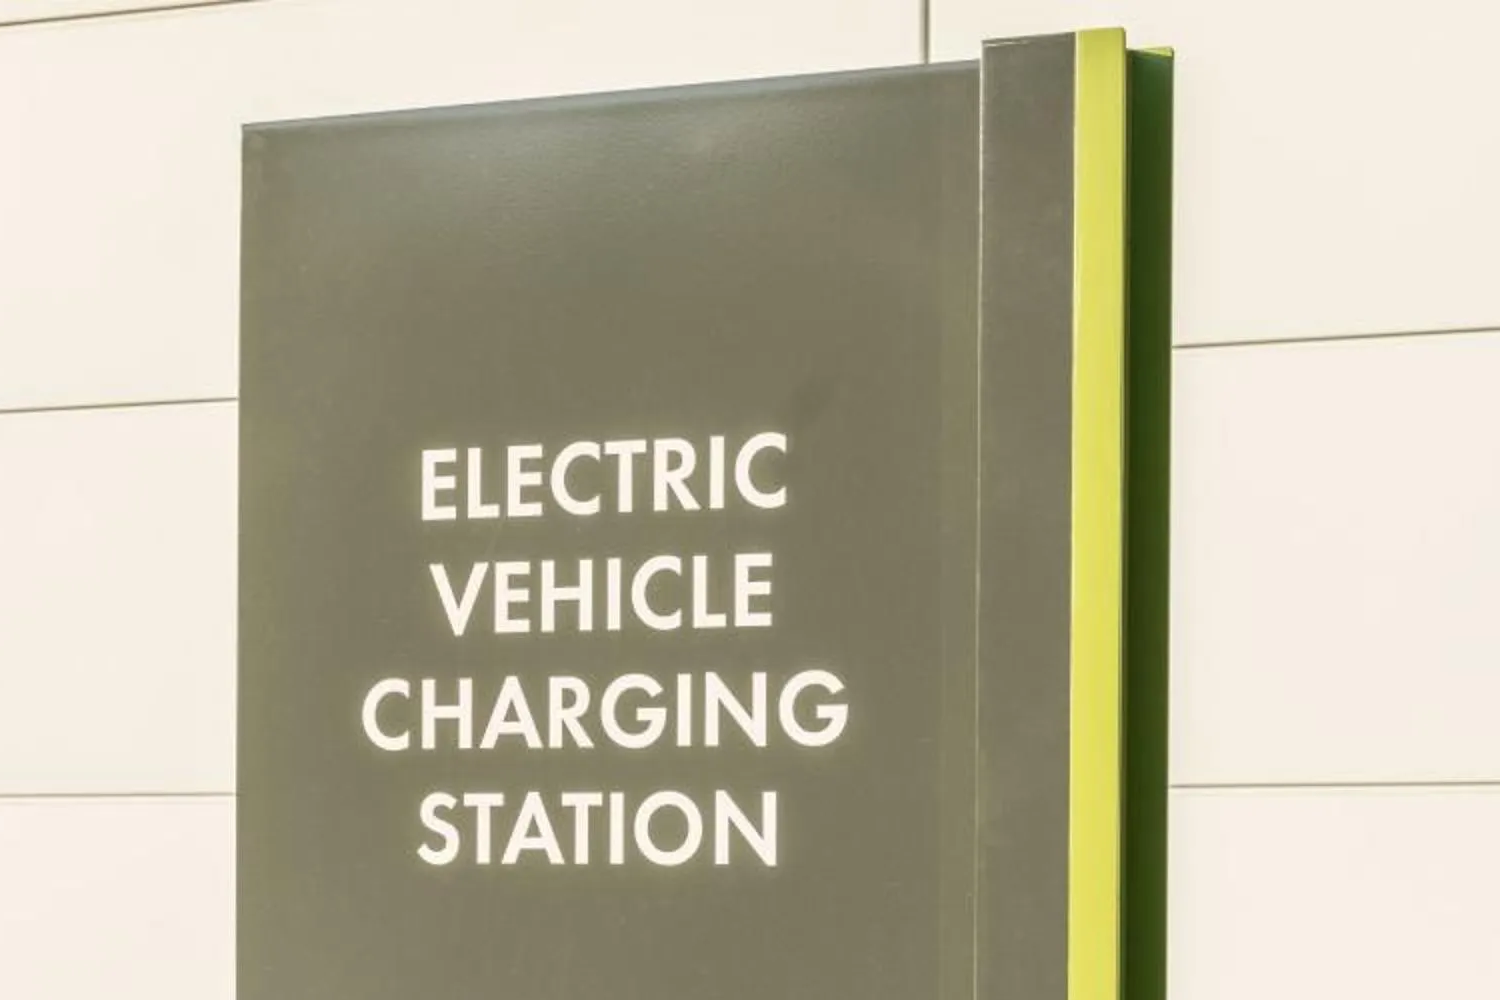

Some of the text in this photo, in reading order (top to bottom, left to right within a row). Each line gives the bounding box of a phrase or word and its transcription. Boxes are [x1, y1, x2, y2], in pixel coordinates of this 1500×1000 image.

[421, 431, 787, 521] ELECTRIC
[429, 553, 773, 636] VEHICLE
[361, 669, 849, 751] CHARGING
[417, 789, 778, 867] STATION
